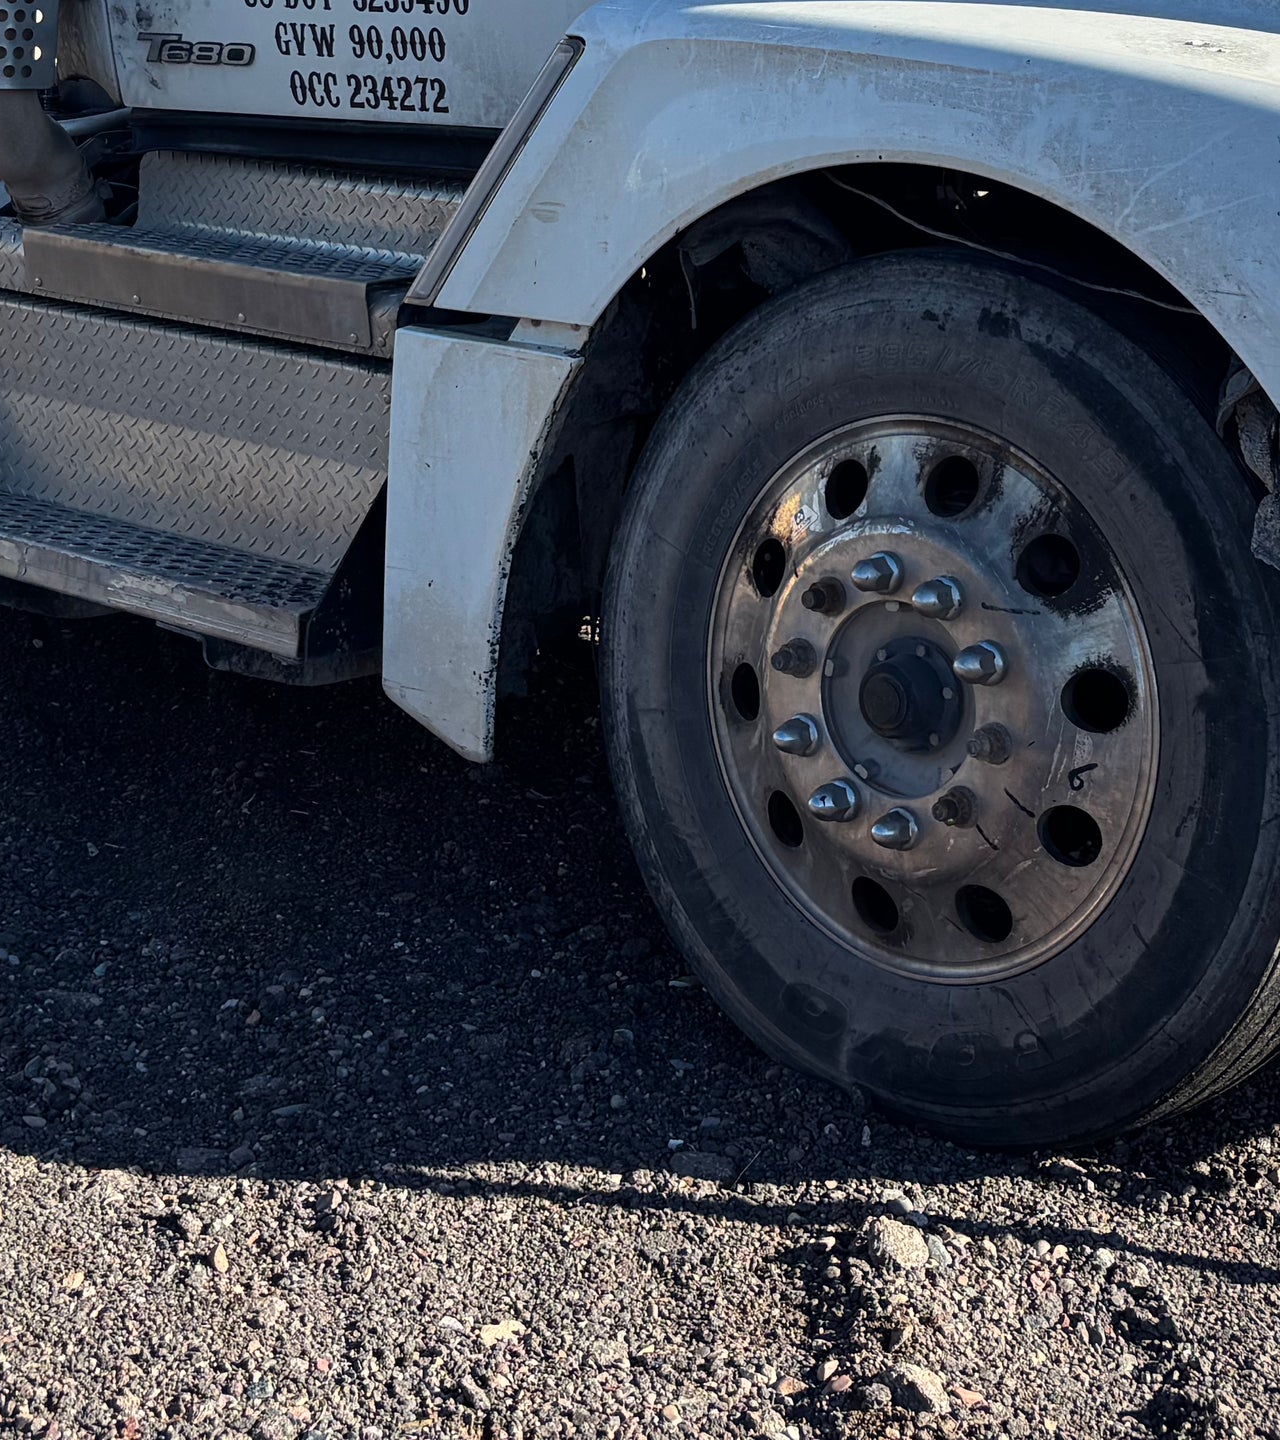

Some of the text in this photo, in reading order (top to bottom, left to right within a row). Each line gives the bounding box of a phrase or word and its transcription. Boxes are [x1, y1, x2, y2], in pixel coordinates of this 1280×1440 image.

[137, 32, 256, 66] T680
[274, 21, 446, 64] GVW 90,000
[289, 70, 450, 114] OCC 234272
